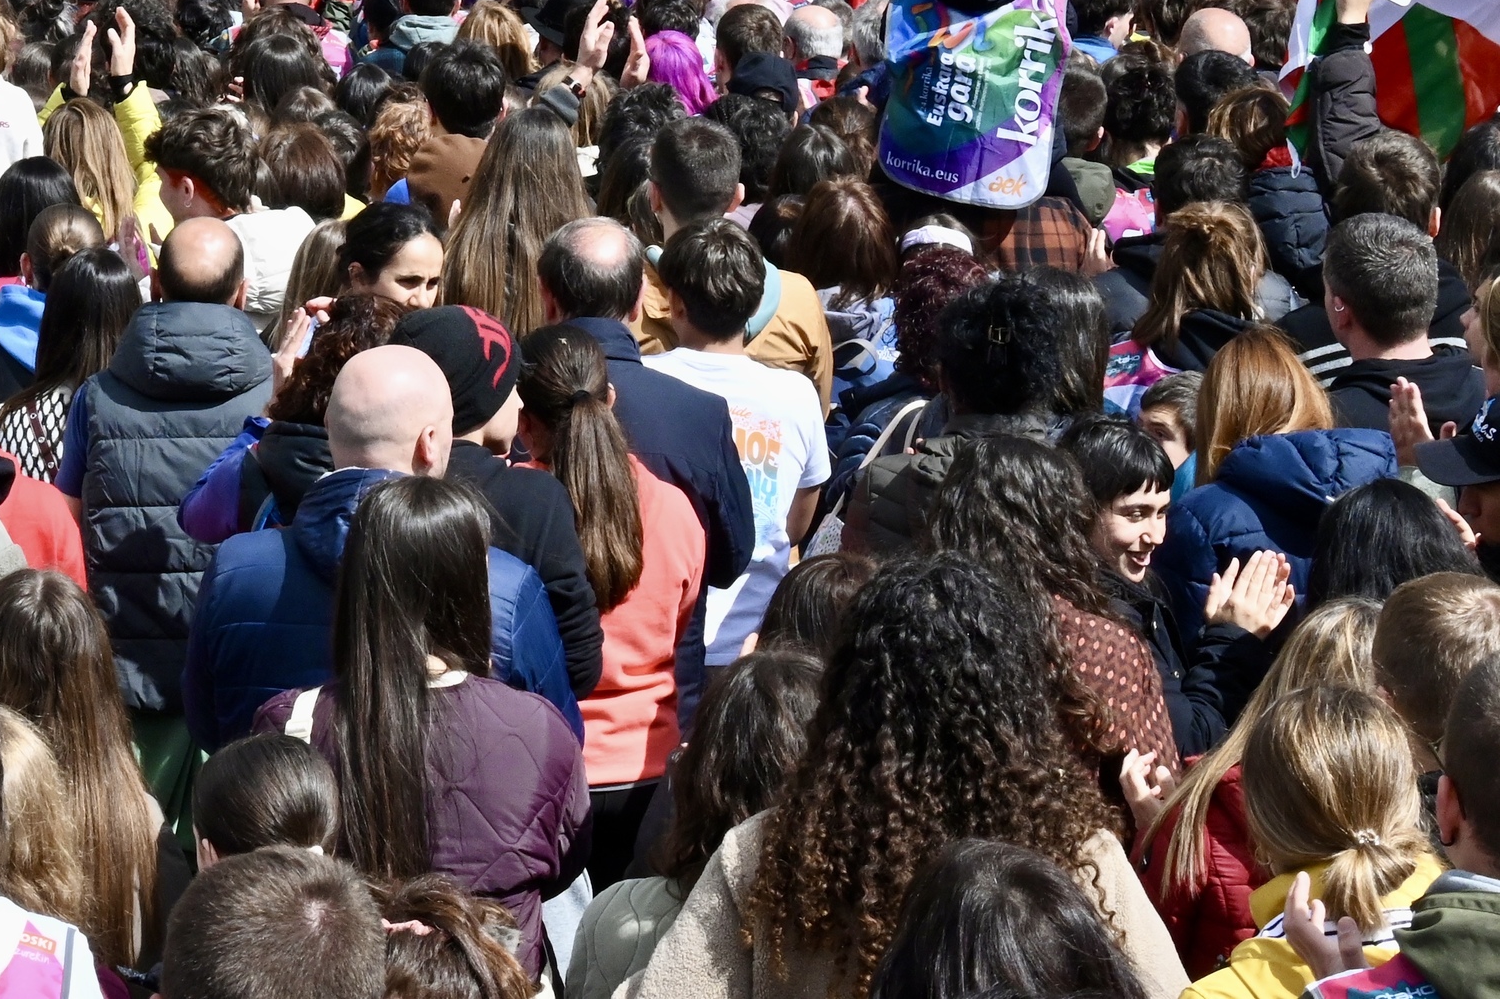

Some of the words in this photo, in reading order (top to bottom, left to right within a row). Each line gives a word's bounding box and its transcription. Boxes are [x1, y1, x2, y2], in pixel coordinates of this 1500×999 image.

[927, 52, 954, 127] Euskara
[947, 52, 977, 124] gara
[886, 151, 959, 183] korrika.eus
[989, 173, 1028, 197] aek
[21, 933, 53, 951] OSKI
